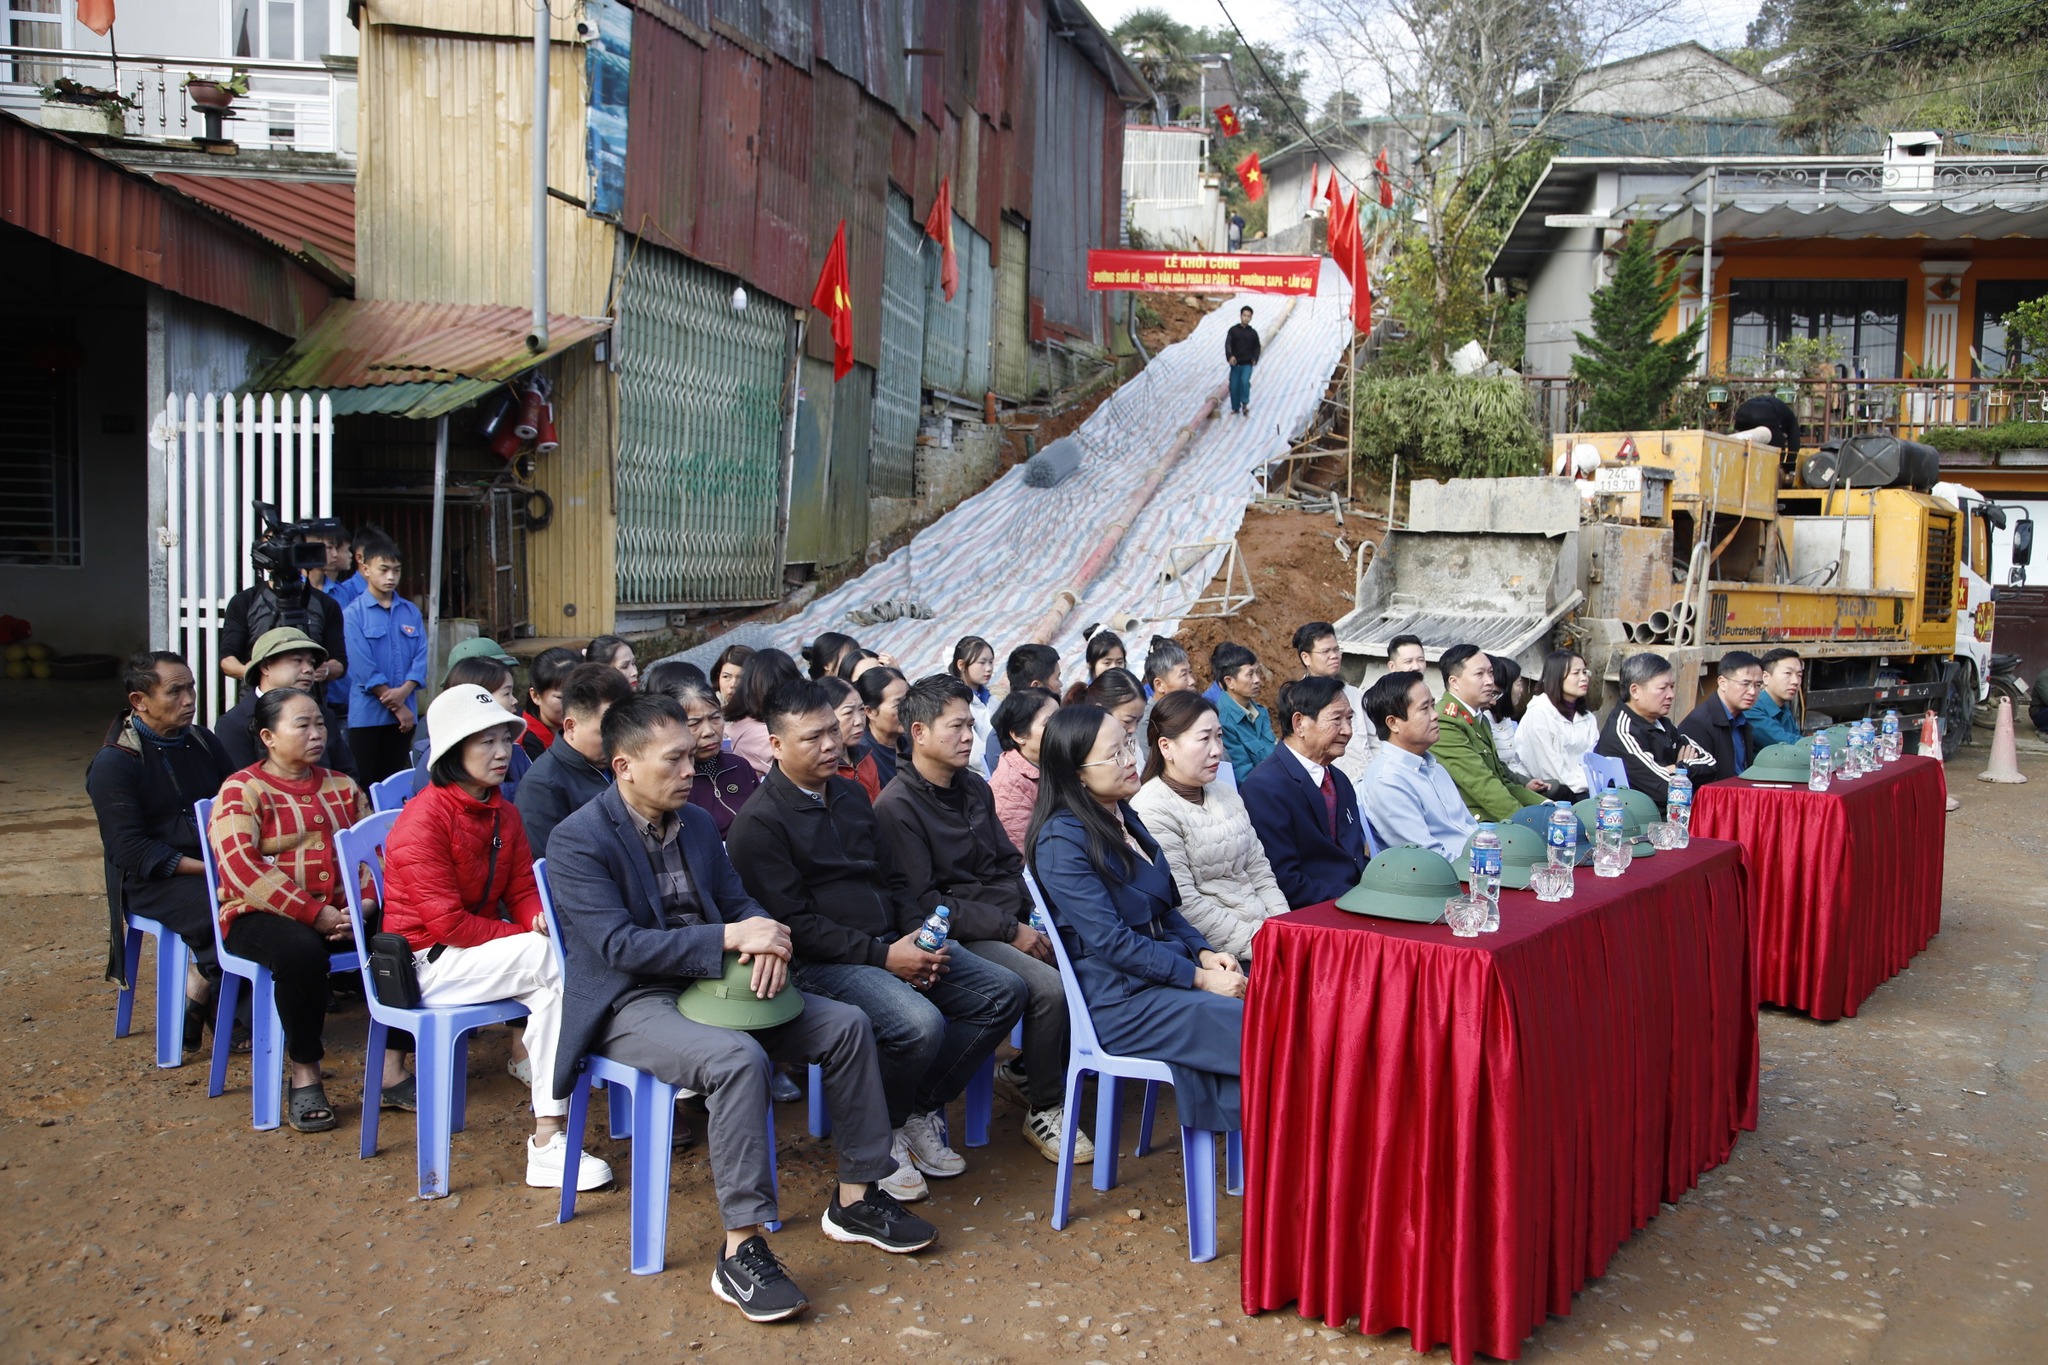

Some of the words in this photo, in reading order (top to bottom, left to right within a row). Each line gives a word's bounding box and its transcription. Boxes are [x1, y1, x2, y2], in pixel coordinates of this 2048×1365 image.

[1209, 255, 1241, 270] CÔNG
[1266, 275, 1283, 287] SAPA
[1300, 277, 1312, 289] CAI
[1608, 468, 1627, 479] 24C
[1601, 480, 1636, 490] 119.70
[1669, 791, 1687, 800] aVie
[921, 932, 938, 943] aVie
